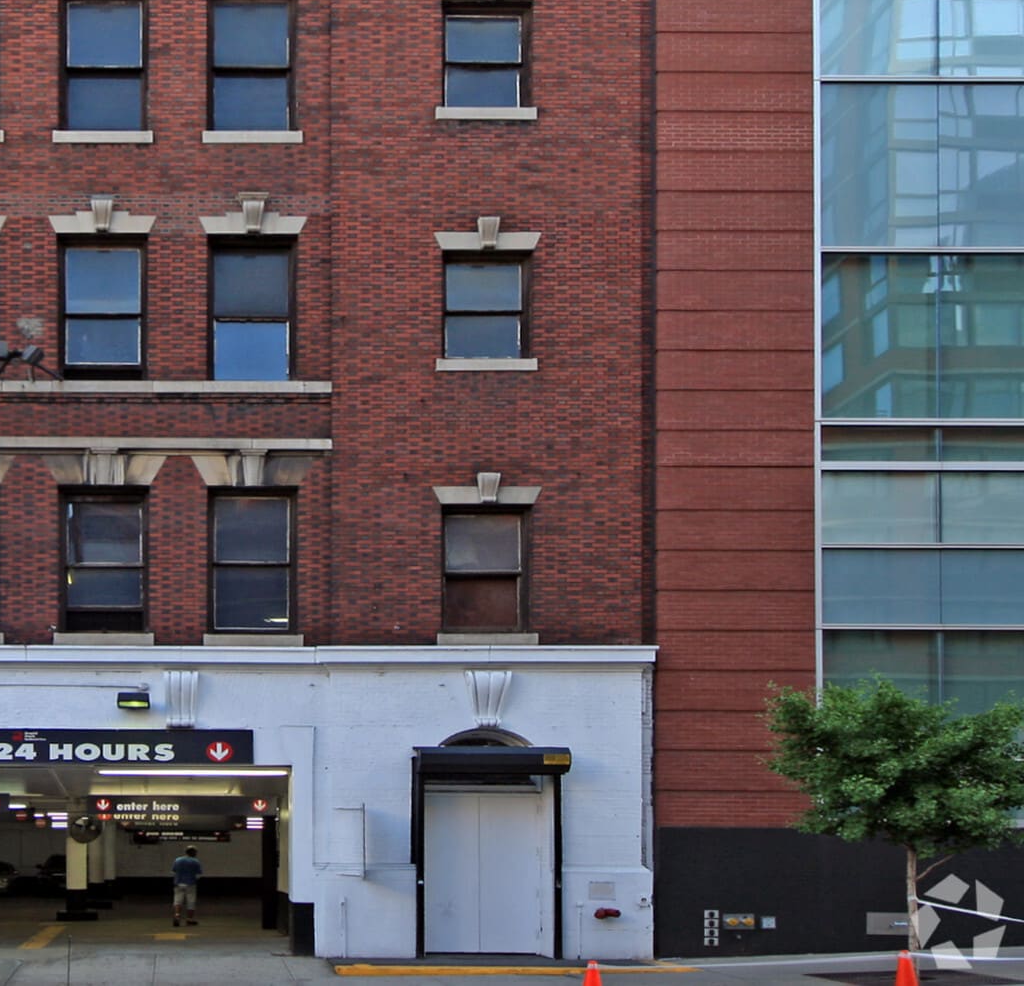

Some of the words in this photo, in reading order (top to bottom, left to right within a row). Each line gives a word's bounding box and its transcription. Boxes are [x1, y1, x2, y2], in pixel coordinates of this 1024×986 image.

[49, 743, 175, 761] HOURS
[116, 802, 149, 812] enter
[152, 801, 180, 812] here
